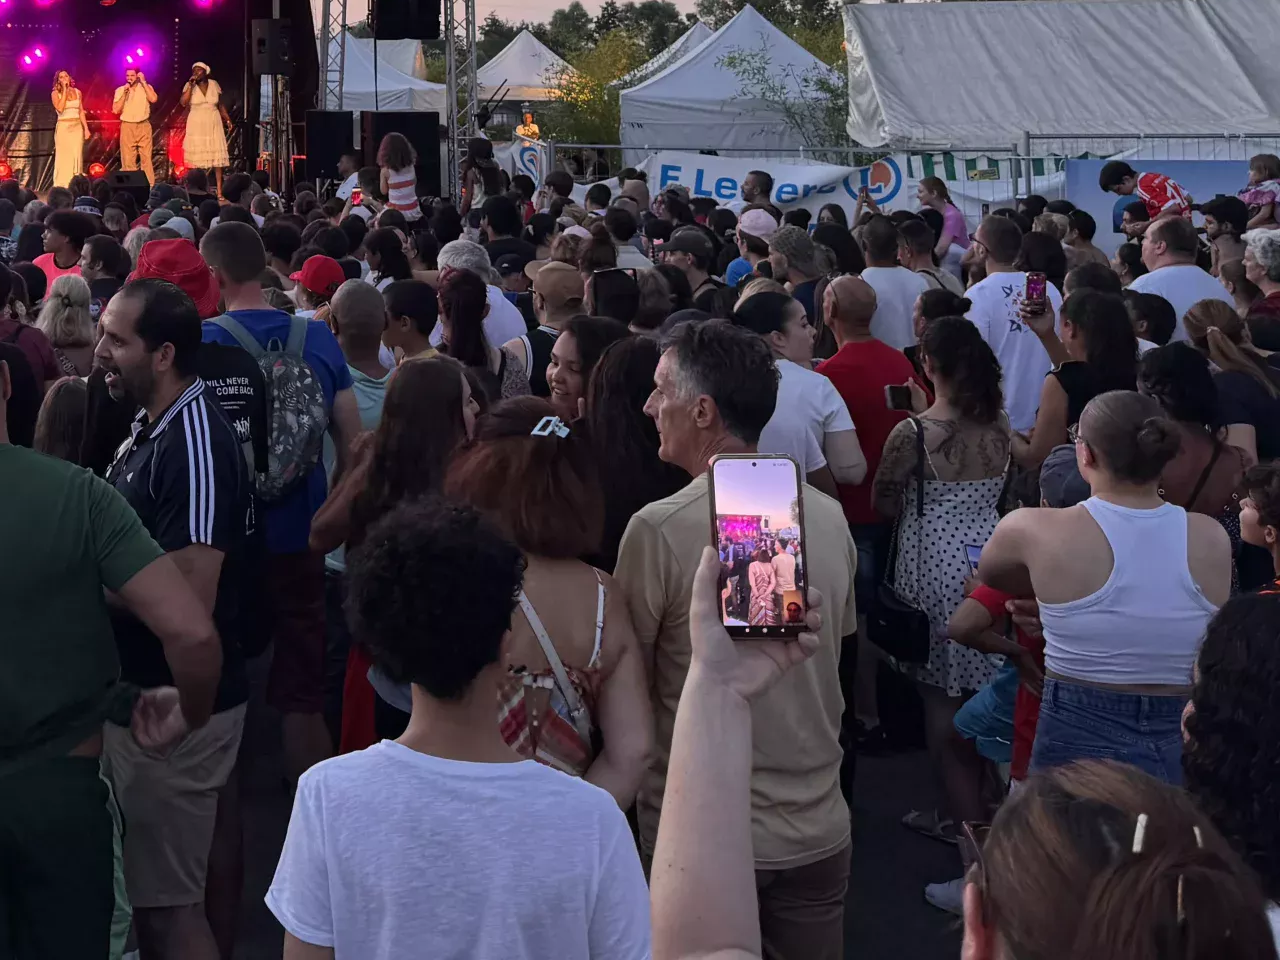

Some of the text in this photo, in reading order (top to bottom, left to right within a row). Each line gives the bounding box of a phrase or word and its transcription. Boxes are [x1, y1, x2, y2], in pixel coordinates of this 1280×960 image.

[226, 377, 249, 385] NEVER
[216, 386, 254, 396] COME BACK
